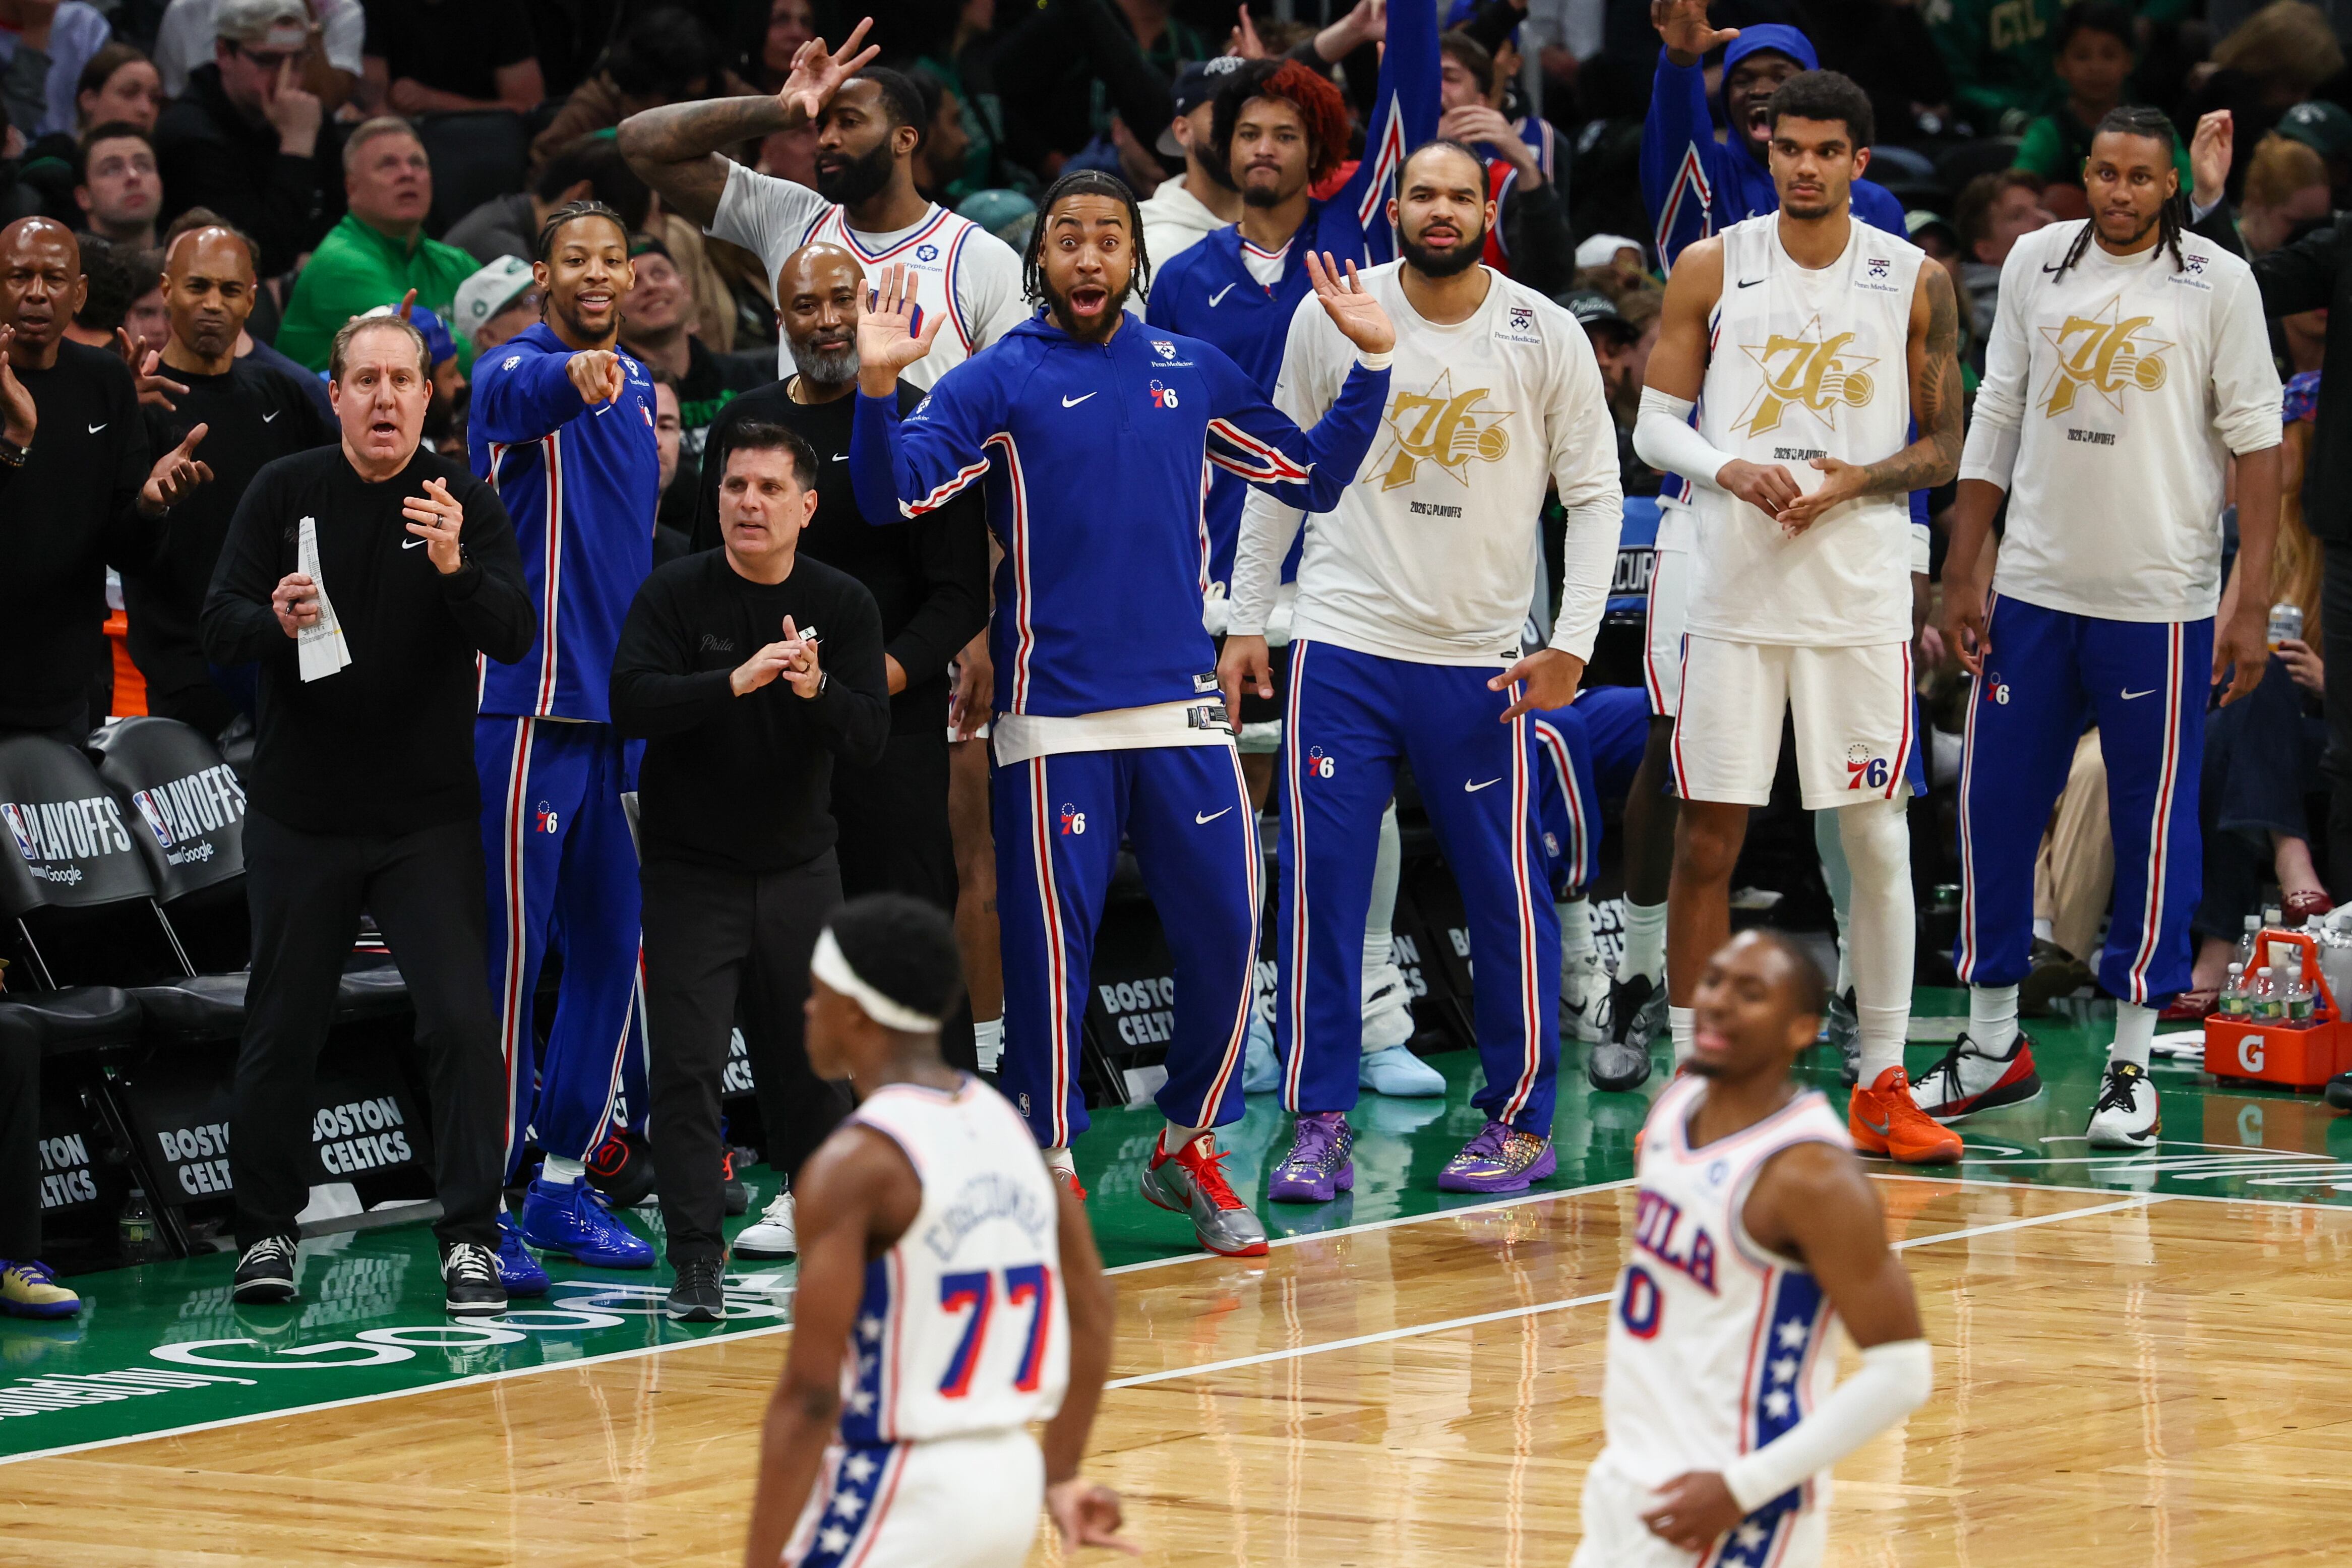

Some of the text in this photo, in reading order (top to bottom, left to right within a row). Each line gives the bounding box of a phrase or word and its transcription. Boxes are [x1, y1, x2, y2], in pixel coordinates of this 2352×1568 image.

[903, 262, 943, 273] crypto.com
[1494, 331, 1540, 344] Penn Medicine
[1151, 388, 1179, 409] 76
[1774, 447, 1791, 460] 2026
[1410, 501, 1462, 518] 2026 PLAYOFFS
[1987, 684, 2010, 705] 76
[1309, 757, 1335, 779] 76
[1847, 758, 1888, 790] 76
[151, 763, 247, 843] PLAYOFFS
[20, 796, 131, 861] PLAYOFFS
[536, 812, 558, 834] 76
[1061, 812, 1085, 835] 76
[182, 839, 214, 864] Google
[46, 865, 83, 886] Google
[2238, 1035, 2265, 1073] G
[39, 1133, 90, 1170] TON
[320, 1130, 412, 1175] CELTICS
[40, 1169, 97, 1209] LTICS
[1619, 1264, 1664, 1342] 0
[938, 1262, 1054, 1400] 77
